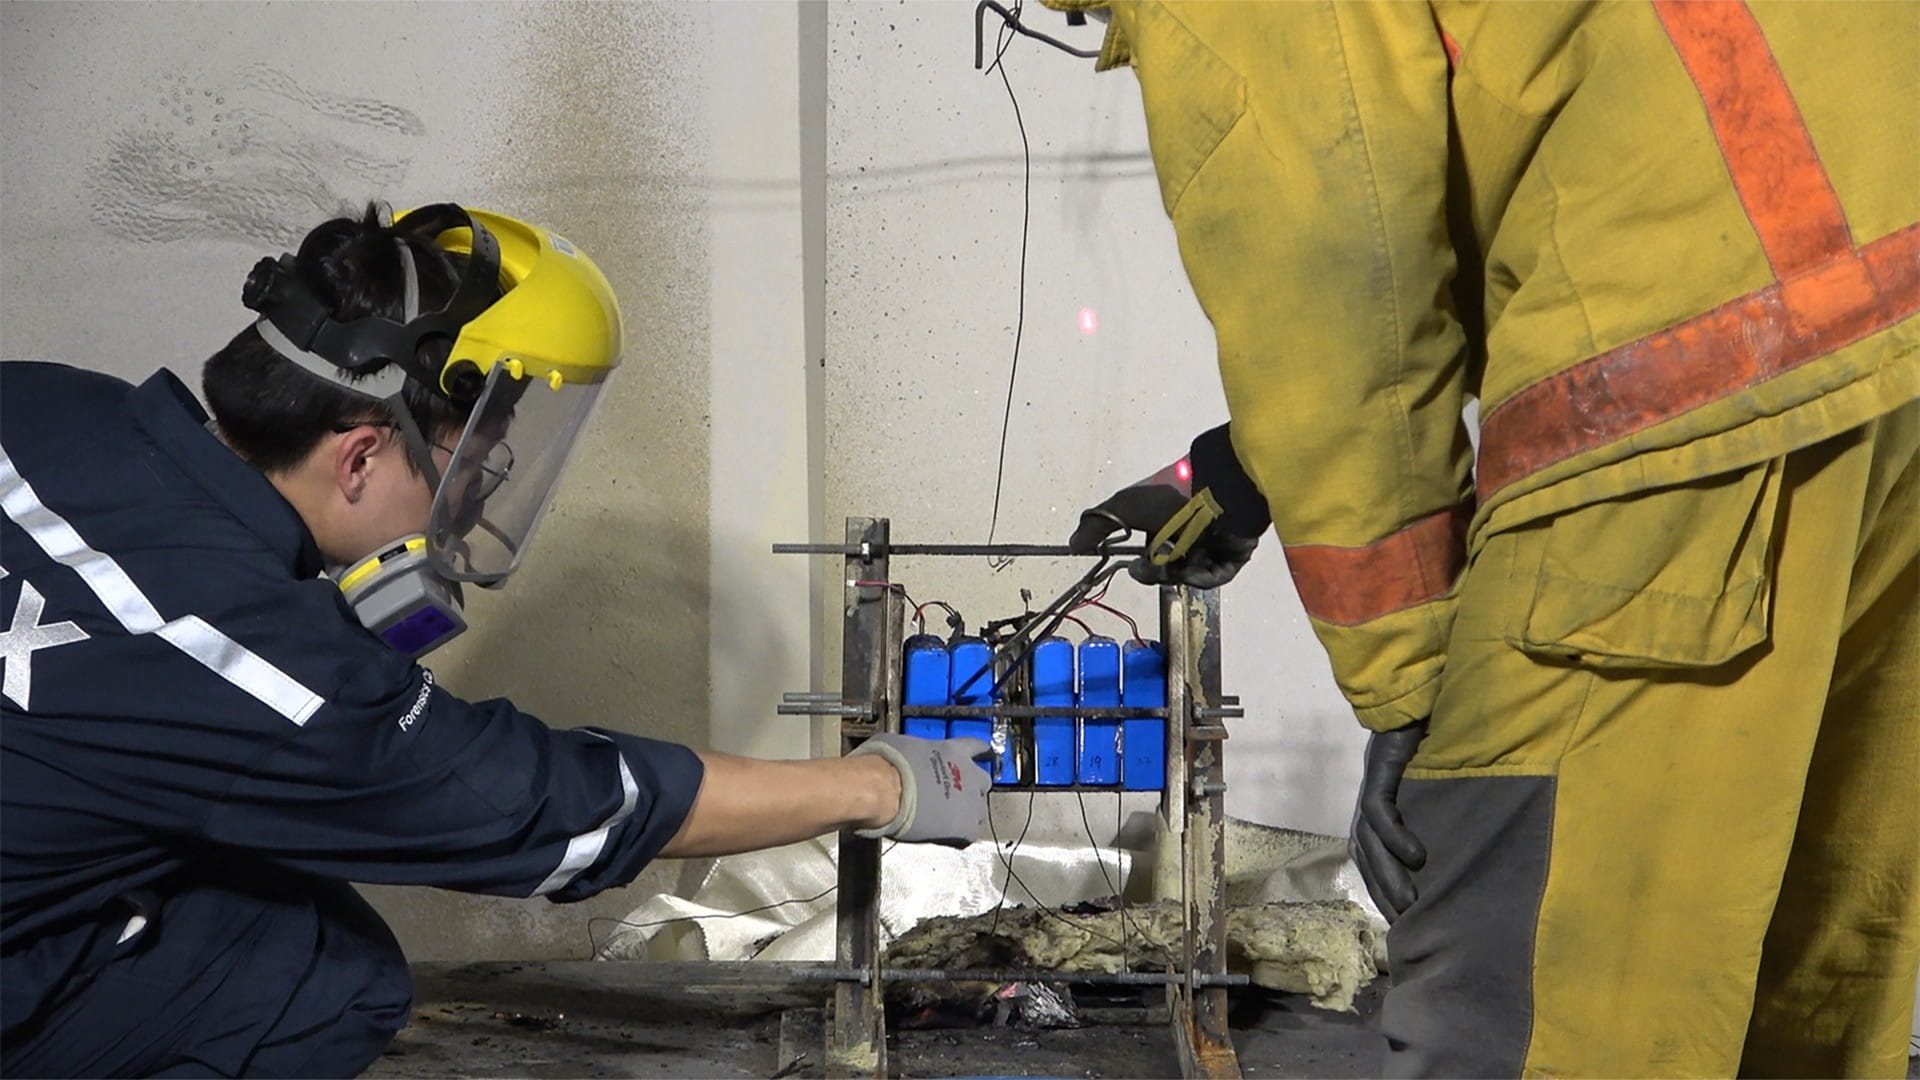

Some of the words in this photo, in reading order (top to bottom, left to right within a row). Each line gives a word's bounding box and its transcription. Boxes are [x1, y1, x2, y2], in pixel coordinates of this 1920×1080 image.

[0, 566, 92, 712] X
[398, 682, 431, 732] Forensics
[947, 761, 963, 792] 3M
[1089, 755, 1102, 769] 19
